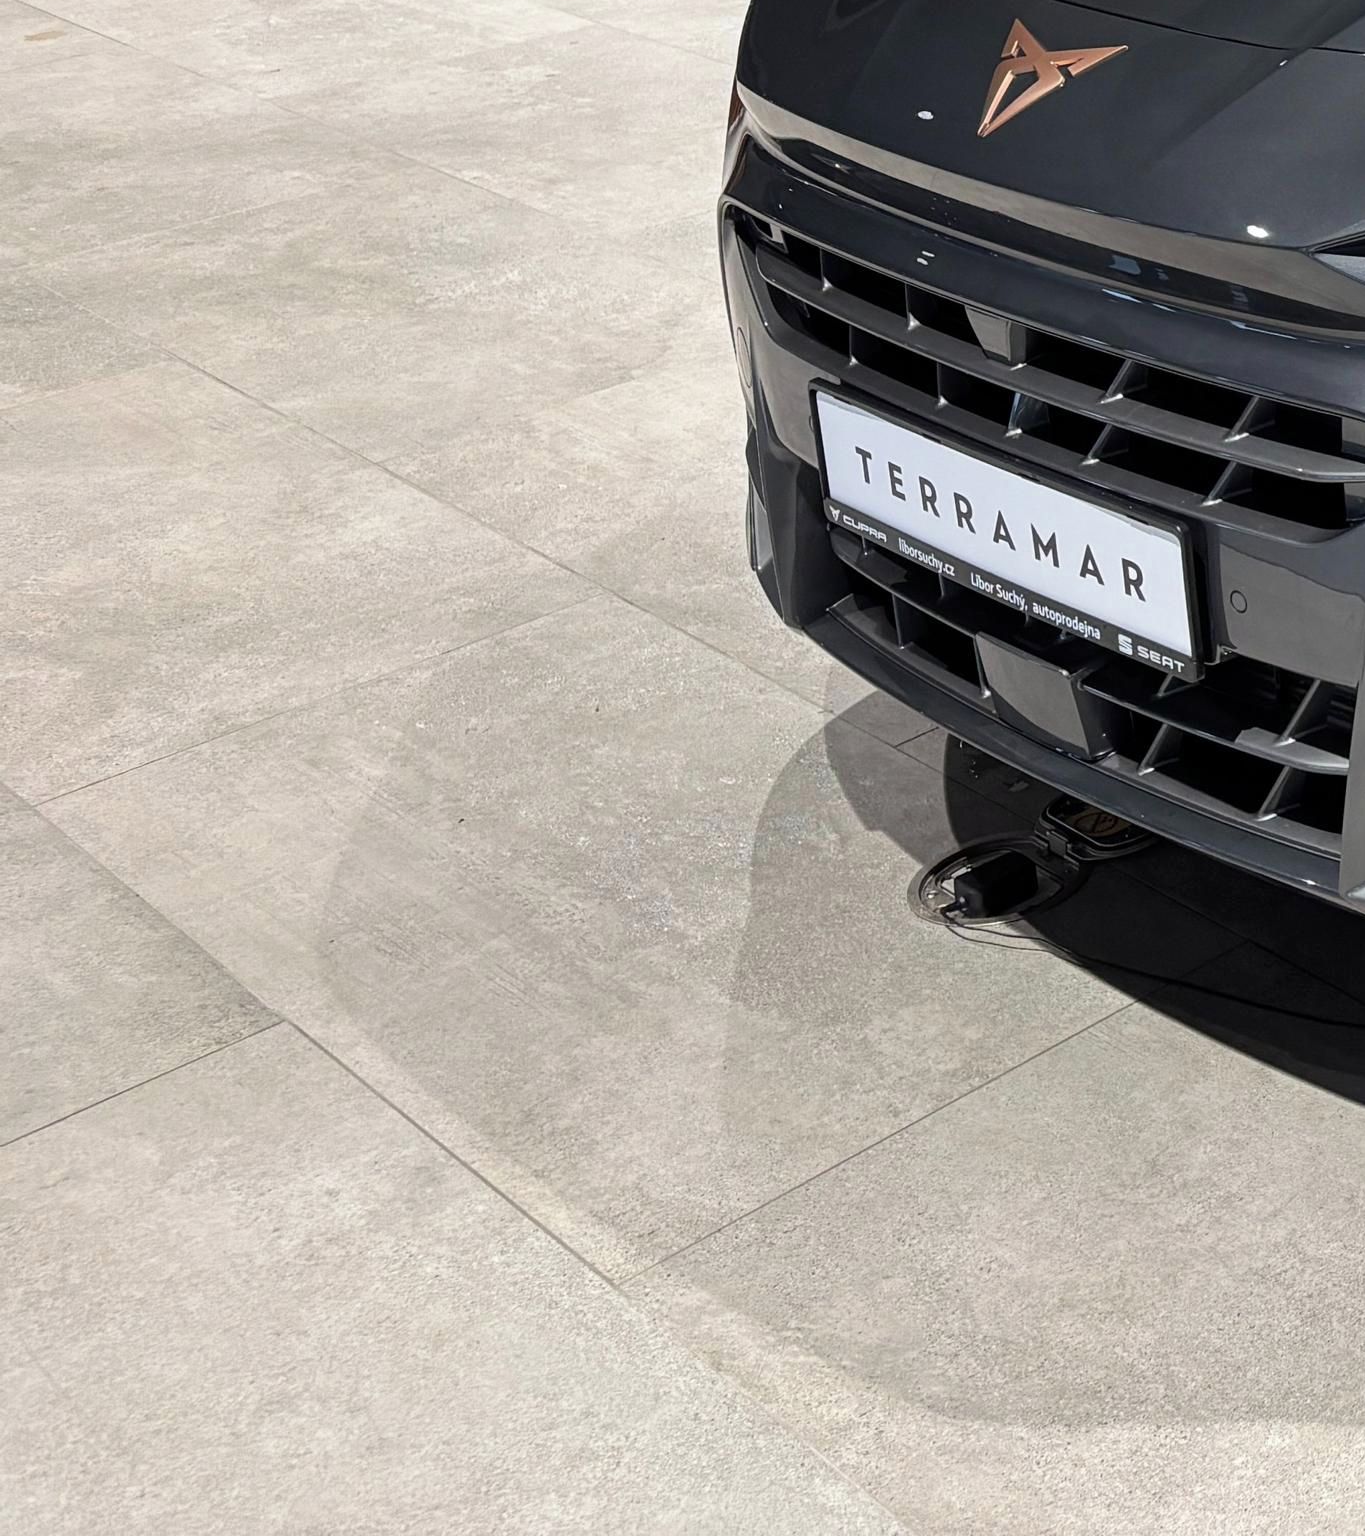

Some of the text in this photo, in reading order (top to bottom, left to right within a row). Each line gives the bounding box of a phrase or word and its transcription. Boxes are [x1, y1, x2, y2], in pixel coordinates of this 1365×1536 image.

[842, 515, 1185, 673] CUPRA liborsuchy.cz Libor Suchý, autoprodejna SEAT
[854, 446, 1147, 603] TERRAMAR
